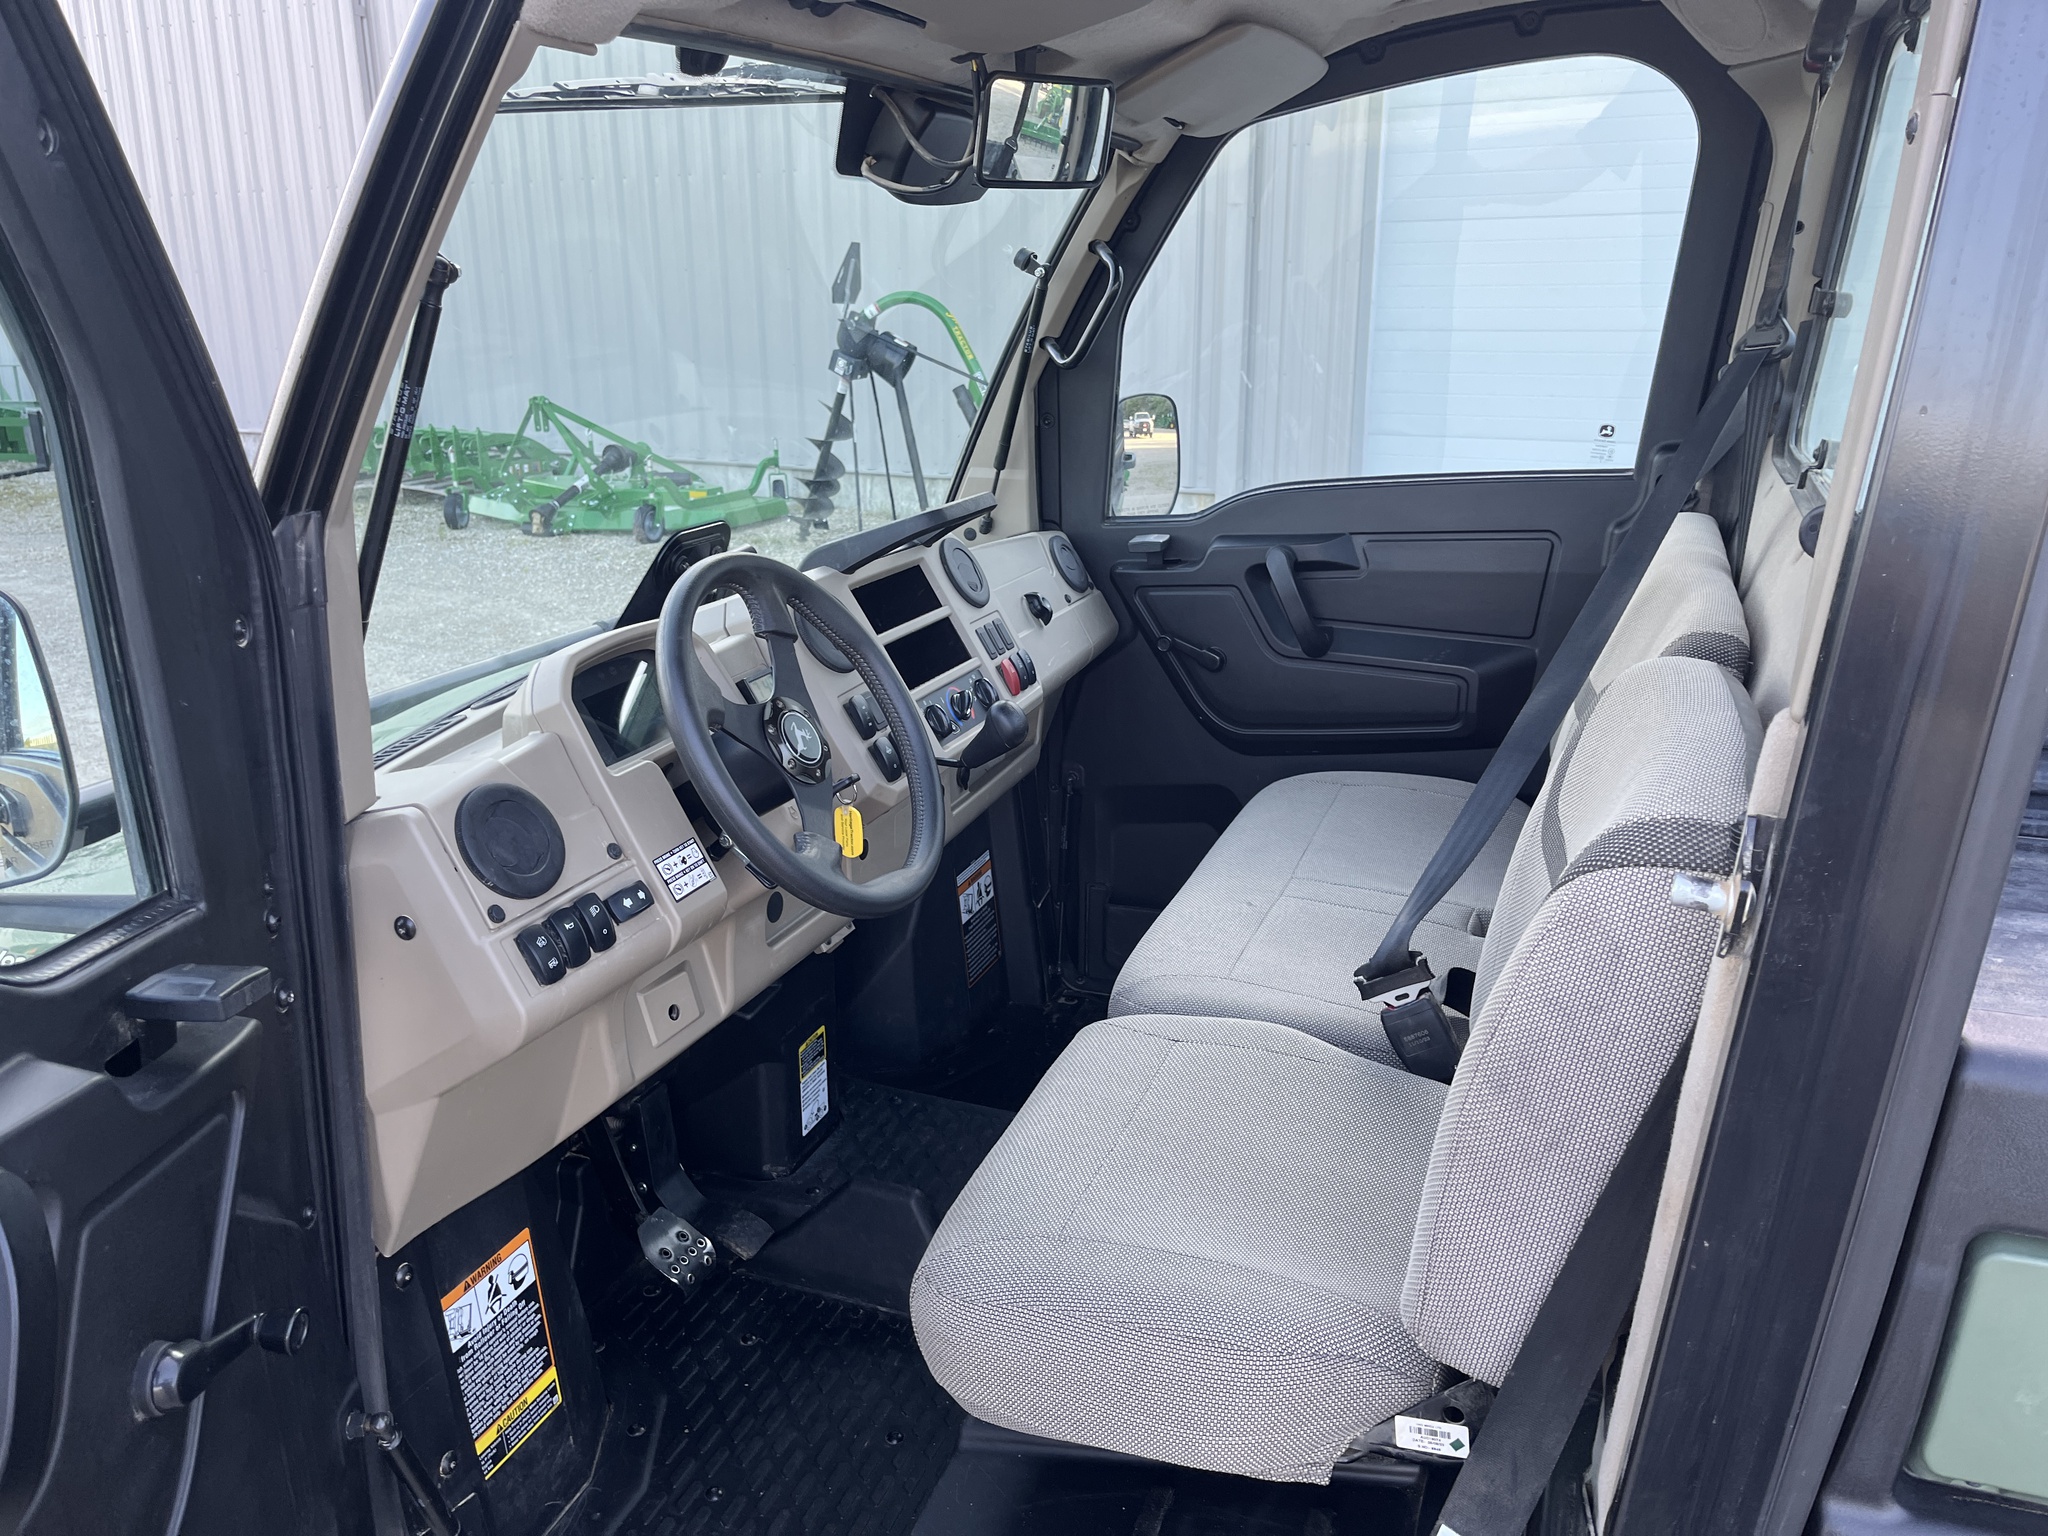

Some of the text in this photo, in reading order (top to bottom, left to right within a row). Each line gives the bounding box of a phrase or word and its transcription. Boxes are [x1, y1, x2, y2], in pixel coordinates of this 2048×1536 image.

[470, 1253, 502, 1285] WARNING
[473, 1328, 495, 1351] Rollover
[502, 1396, 529, 1428] CAUTION
